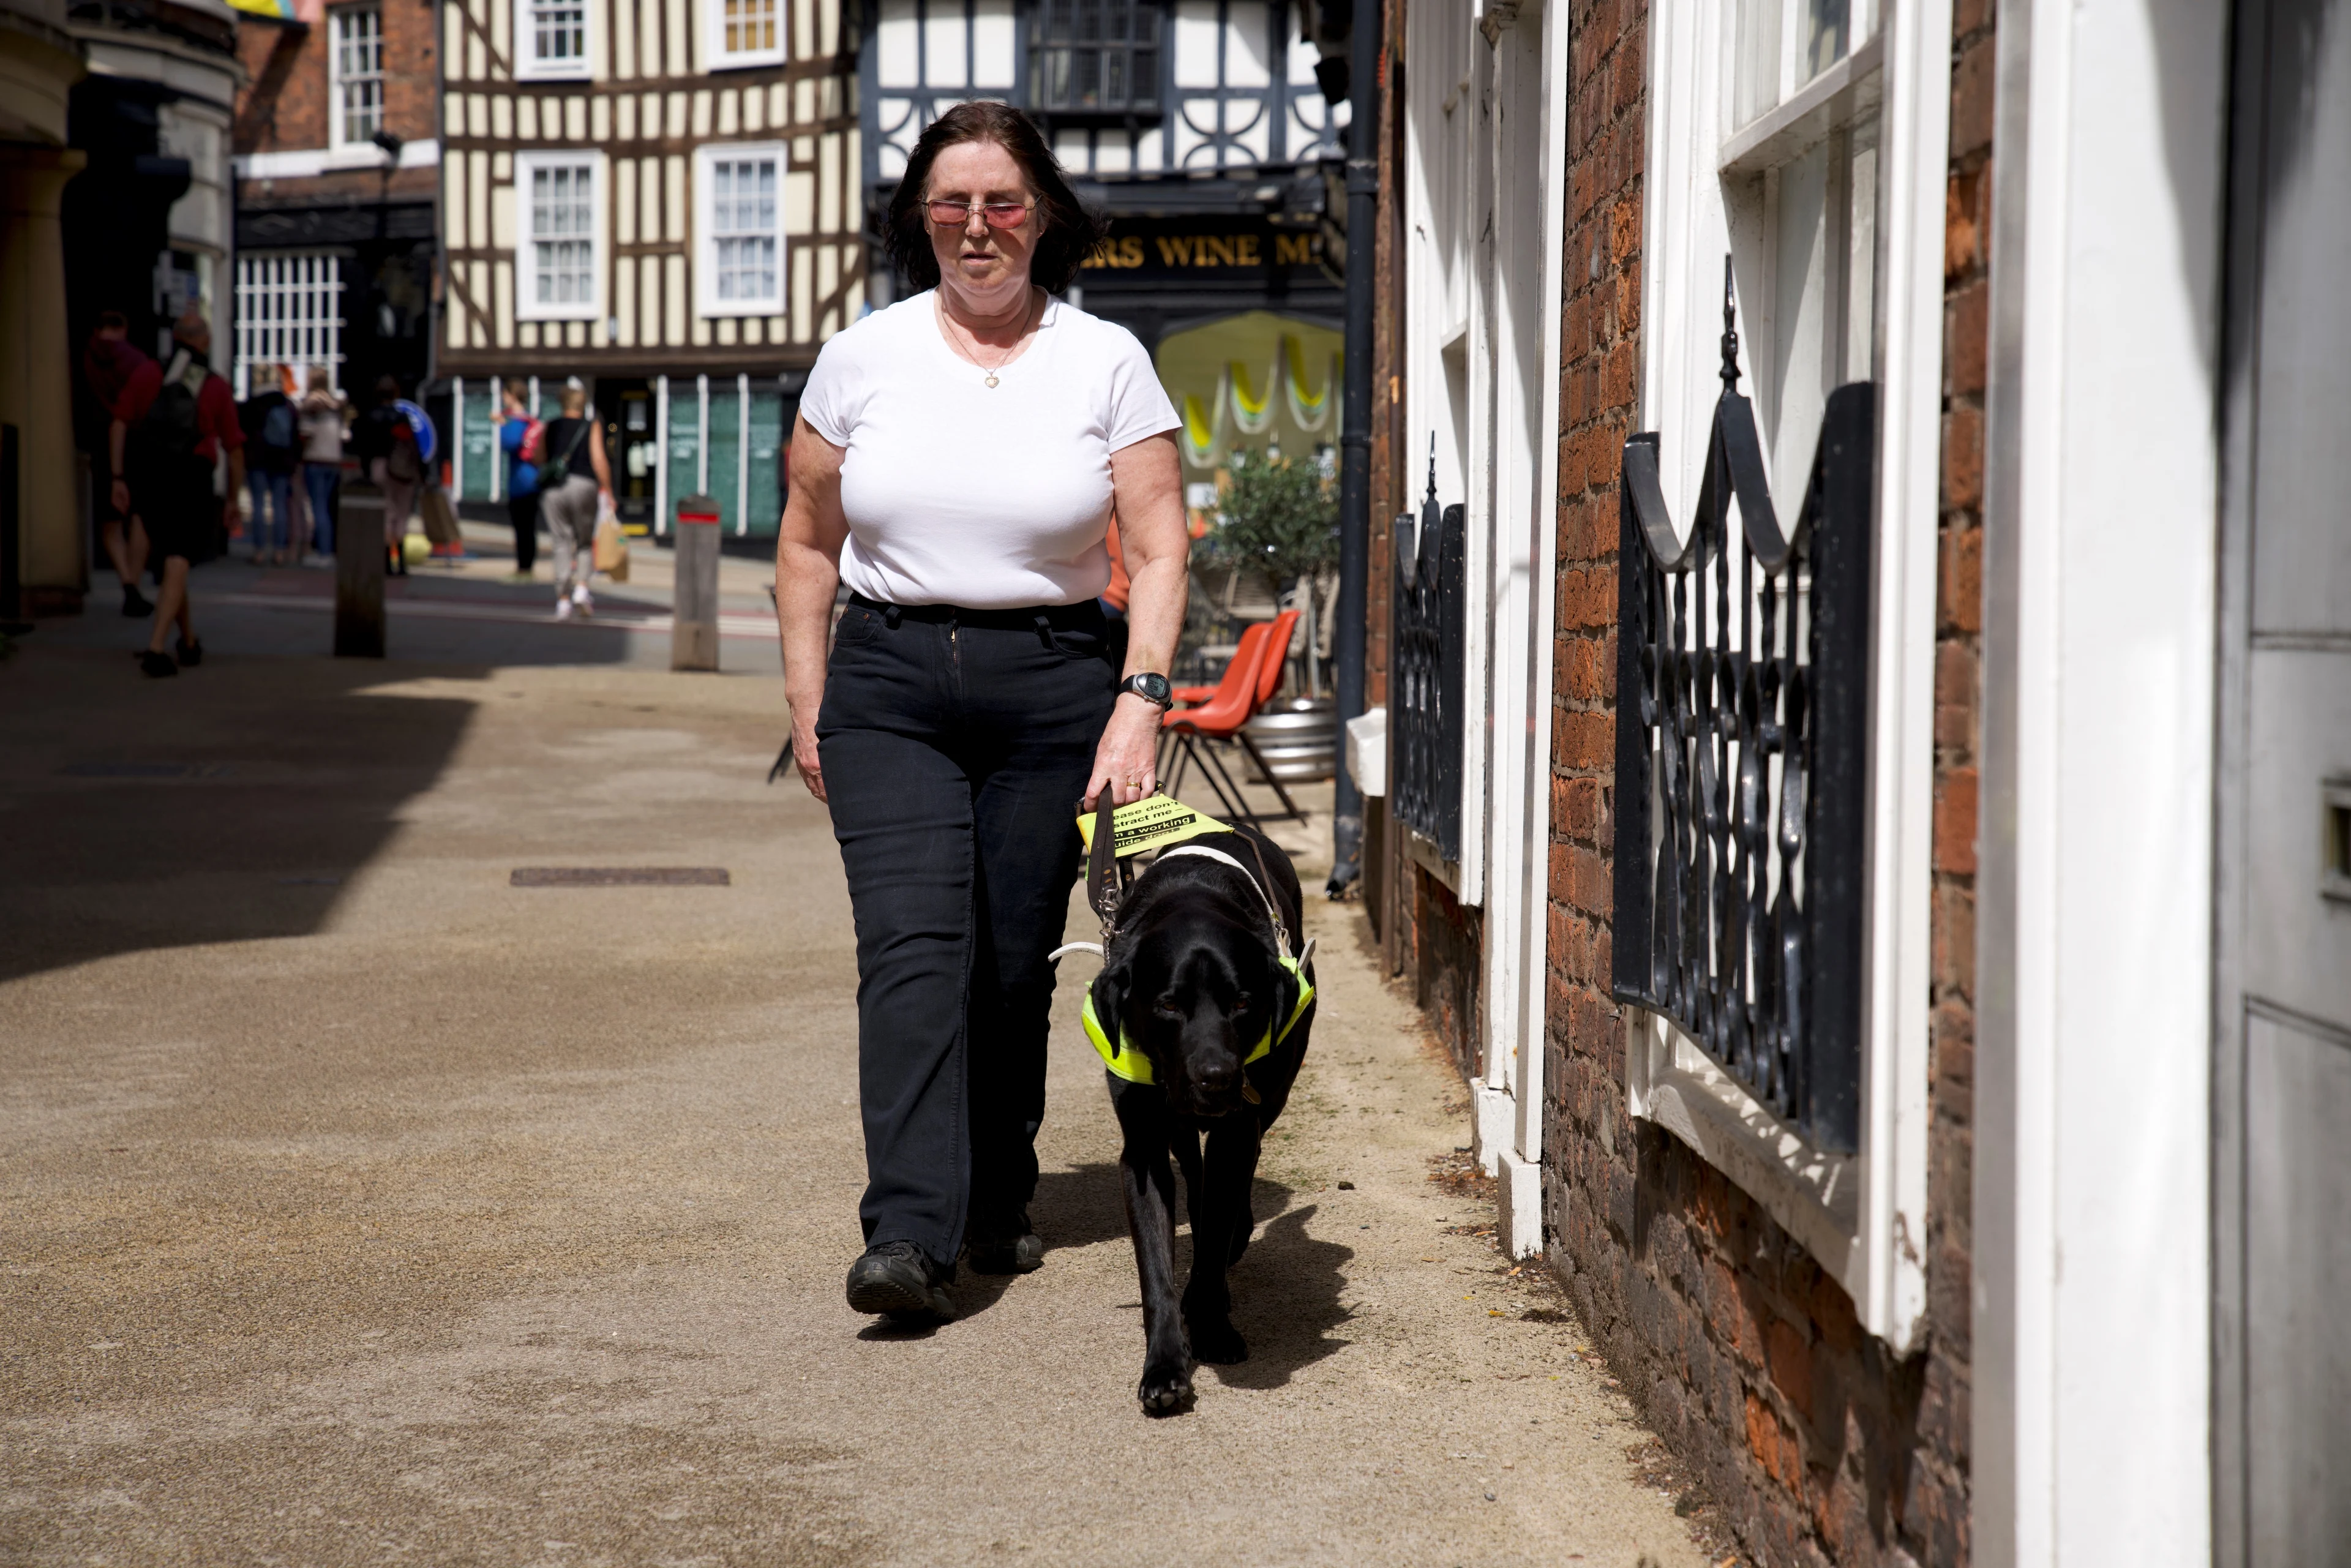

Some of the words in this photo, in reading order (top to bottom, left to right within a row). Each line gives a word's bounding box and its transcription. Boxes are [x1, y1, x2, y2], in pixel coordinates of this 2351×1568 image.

[1155, 234, 1262, 268] WINE
[1146, 801, 1179, 811] don't
[1139, 817, 1190, 833] working
